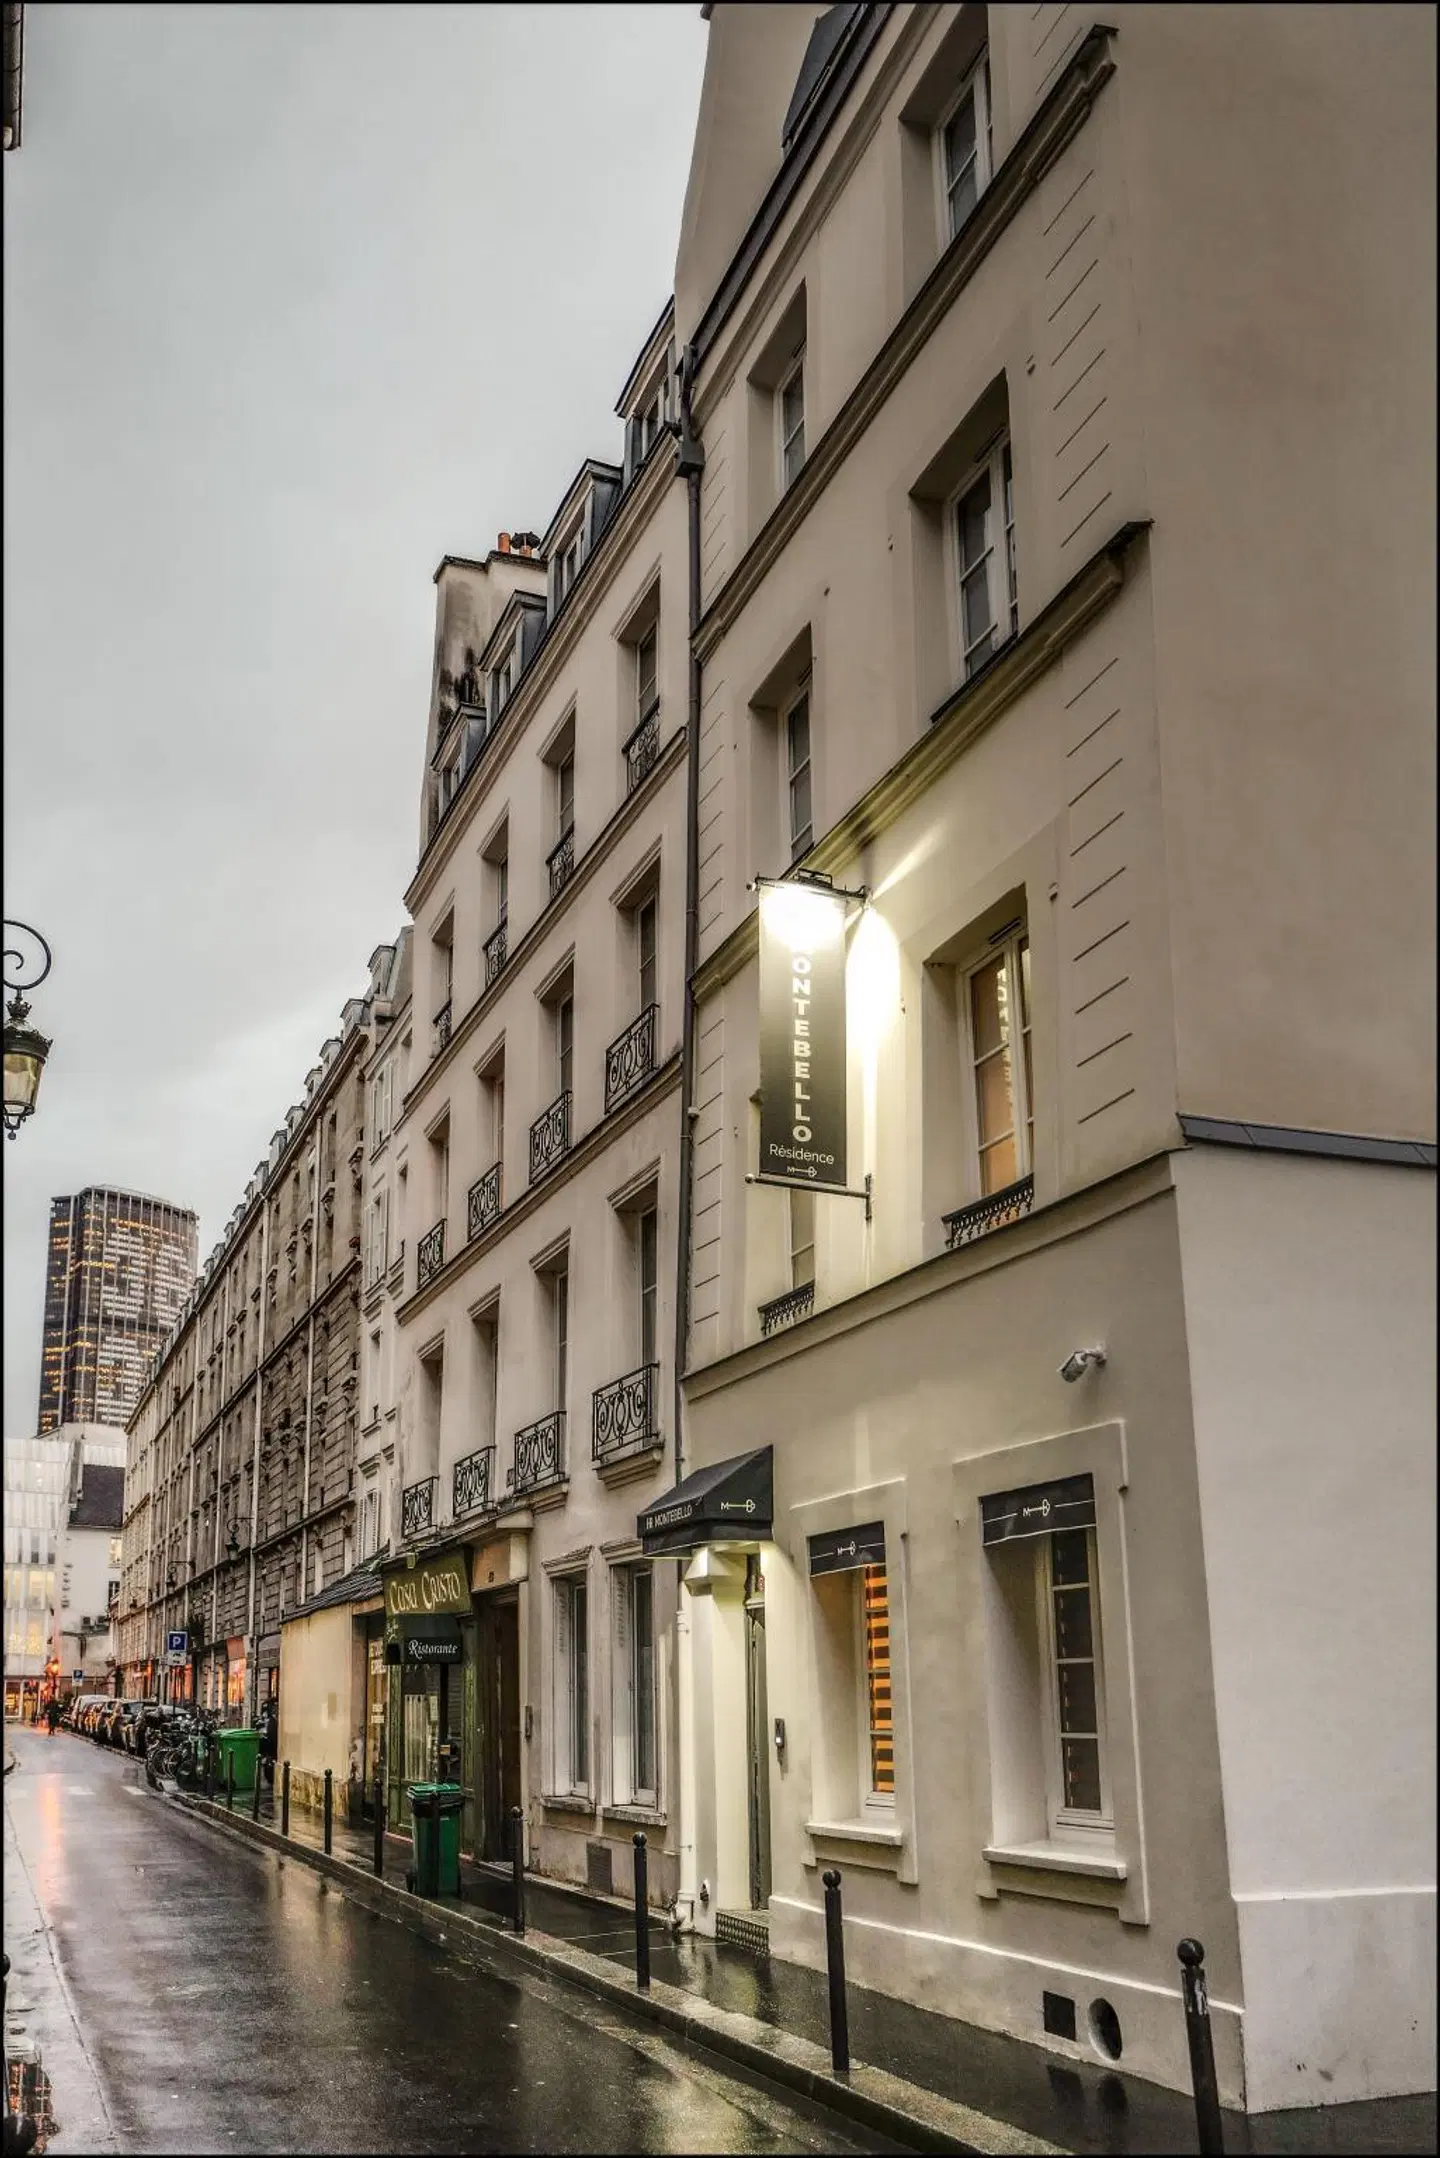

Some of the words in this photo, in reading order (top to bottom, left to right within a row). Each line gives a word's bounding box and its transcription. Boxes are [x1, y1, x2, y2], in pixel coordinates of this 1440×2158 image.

[792, 955, 812, 1142] ONTEBELLO
[769, 1143, 835, 1165] Résidence
[654, 1504, 693, 1528] MONTEBELLO
[173, 1636, 181, 1648] P
[408, 1639, 458, 1660] Ristorante
